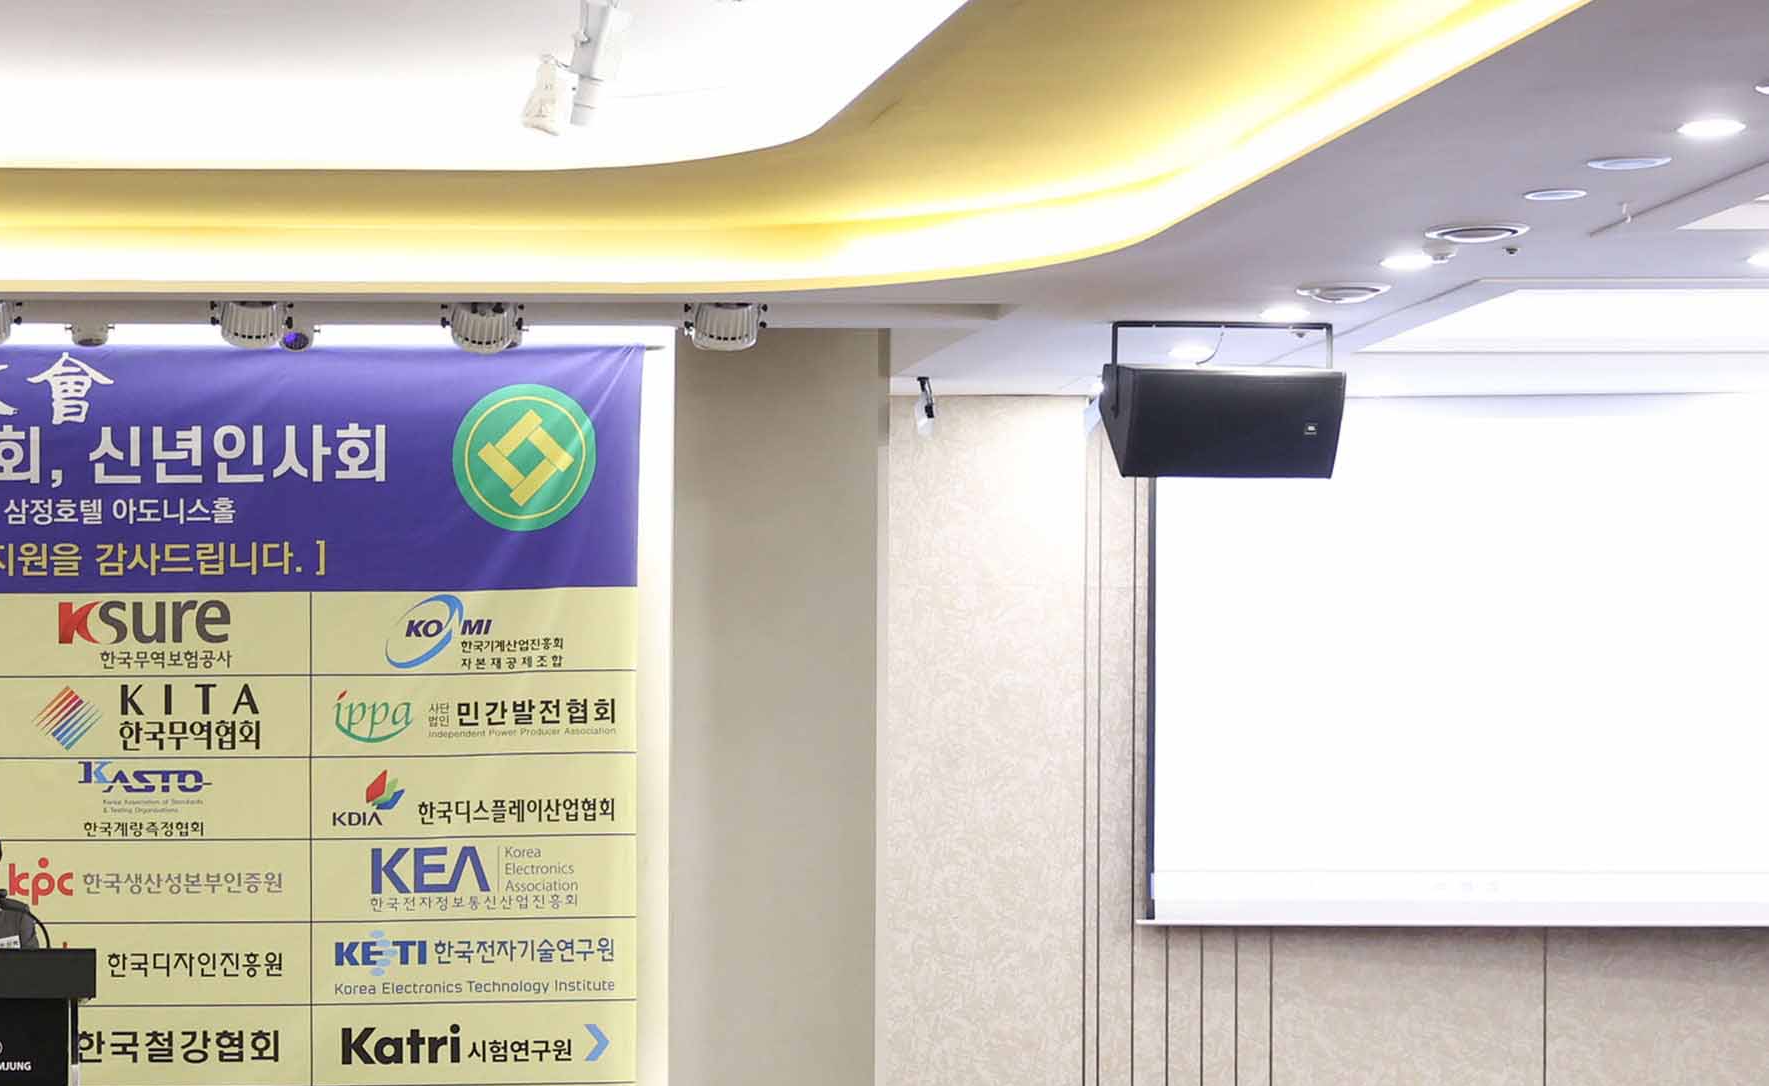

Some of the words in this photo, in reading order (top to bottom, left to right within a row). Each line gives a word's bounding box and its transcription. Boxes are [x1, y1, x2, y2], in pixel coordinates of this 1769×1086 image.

[87, 423, 389, 485] 신년인사회
[4, 497, 103, 526] 삼정호텔
[111, 497, 237, 526] 아도니스홀
[96, 540, 303, 577] 감사드립니다.
[461, 637, 564, 654] 한국기계산업진흥회
[100, 651, 233, 670] 한국무역보험공사
[457, 698, 617, 727] 민간발전협회
[119, 720, 261, 751] 한국무역협회
[489, 728, 517, 737] Power
[520, 727, 560, 737] Producer
[564, 726, 616, 736] Association
[78, 761, 212, 793] KASTO
[333, 812, 382, 826] KDIA
[418, 798, 616, 824] 한국디스플레이산업협회
[84, 821, 205, 837] 한국계량측정협회
[504, 847, 542, 858] Korea
[8, 857, 74, 906] kpc
[371, 846, 490, 894] KEA
[504, 863, 575, 875] Electronics
[83, 872, 283, 895] 한국생산성본부인증원
[504, 879, 579, 892] Association
[370, 893, 578, 913] 한국전자정보통신산업진흥회
[434, 937, 614, 964] 한국전자기술연구원
[107, 952, 283, 978] 한국디자인진흥원
[334, 982, 376, 995] Korea
[382, 981, 463, 995] Electronics
[466, 980, 549, 995] Technology
[554, 978, 615, 992] Institute
[78, 1030, 280, 1064] 한국철강협회
[341, 1023, 461, 1065] Katri
[468, 1039, 572, 1063] 시험연구원
